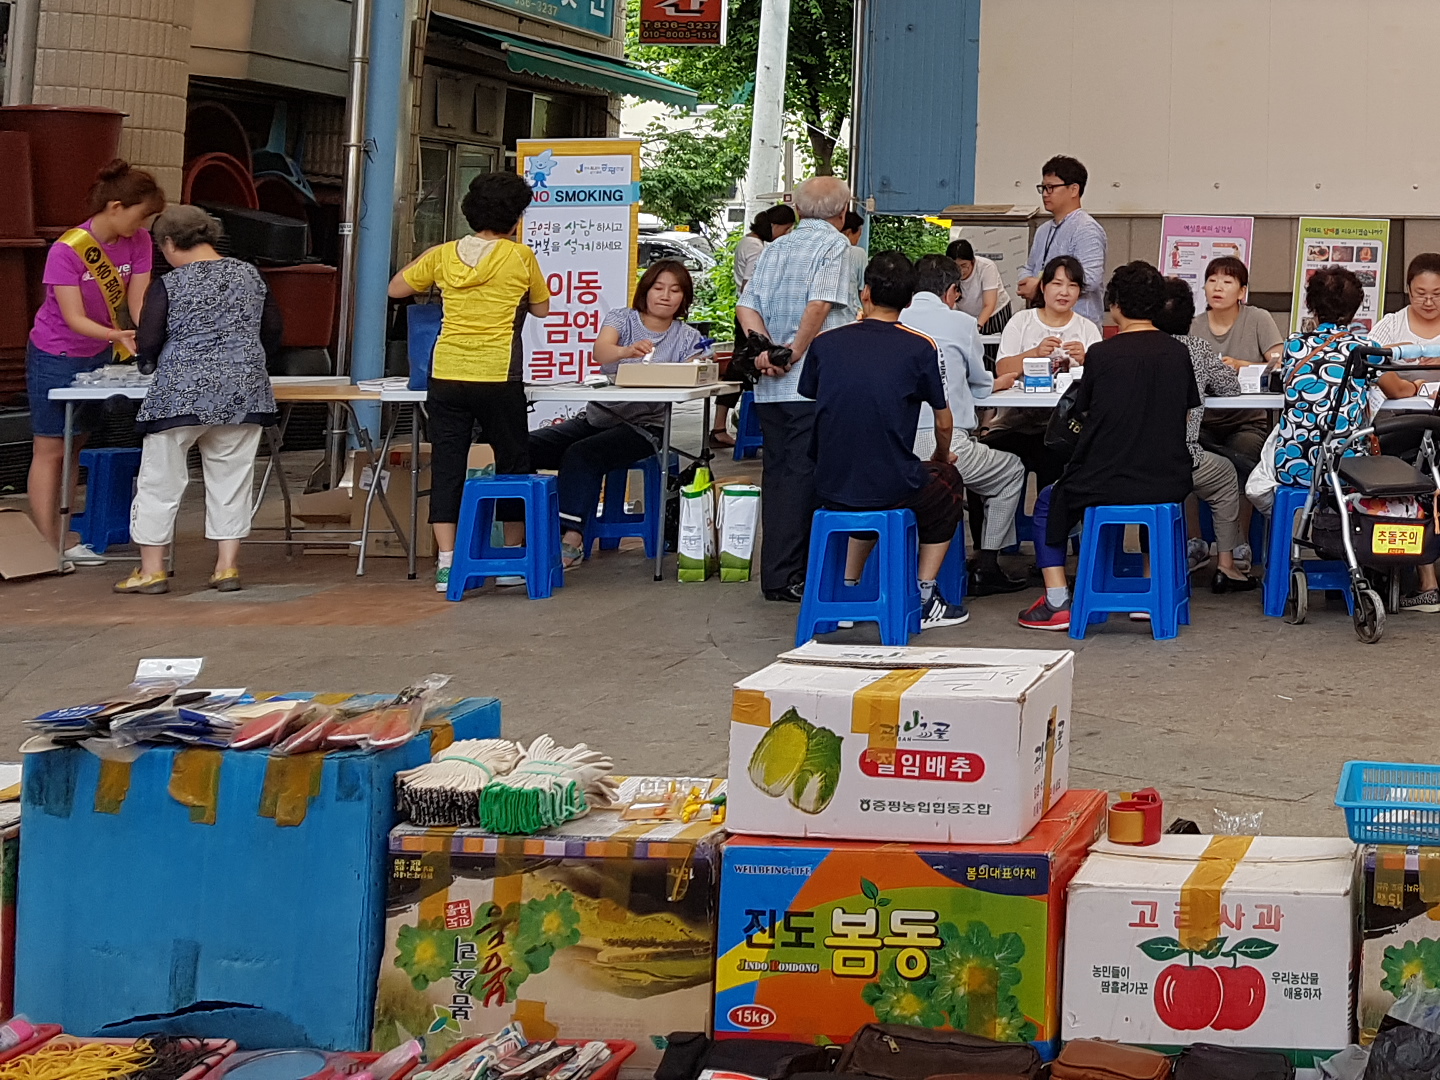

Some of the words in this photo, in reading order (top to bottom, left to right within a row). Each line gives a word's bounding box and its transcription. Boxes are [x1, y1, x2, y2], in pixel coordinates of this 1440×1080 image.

[654, 22, 719, 30] 836-3237
[643, 30, 718, 39] 010-8005-1514
[555, 190, 623, 202] SMOKING
[527, 220, 561, 234] 금연을
[564, 220, 595, 237] 상담
[596, 223, 623, 233] 하시고
[527, 238, 561, 256] 행복을
[564, 239, 594, 255] 설계
[596, 241, 622, 251] 하세요
[547, 271, 602, 304] 이동
[543, 310, 599, 344] 금연
[1377, 531, 1418, 545] 추돌주의
[877, 752, 972, 779] 절임배추
[872, 800, 993, 815] 증평농업협동조합
[743, 908, 816, 950] 진도
[823, 906, 944, 981] 봄동
[447, 935, 478, 1021] 봄소리
[1092, 964, 1130, 979] 농민들이
[1271, 971, 1320, 986] 우리농산물
[1101, 980, 1149, 995] 땀흘려가꾼
[1283, 987, 1322, 1001] 애용하자
[735, 1009, 771, 1026] 15kg
